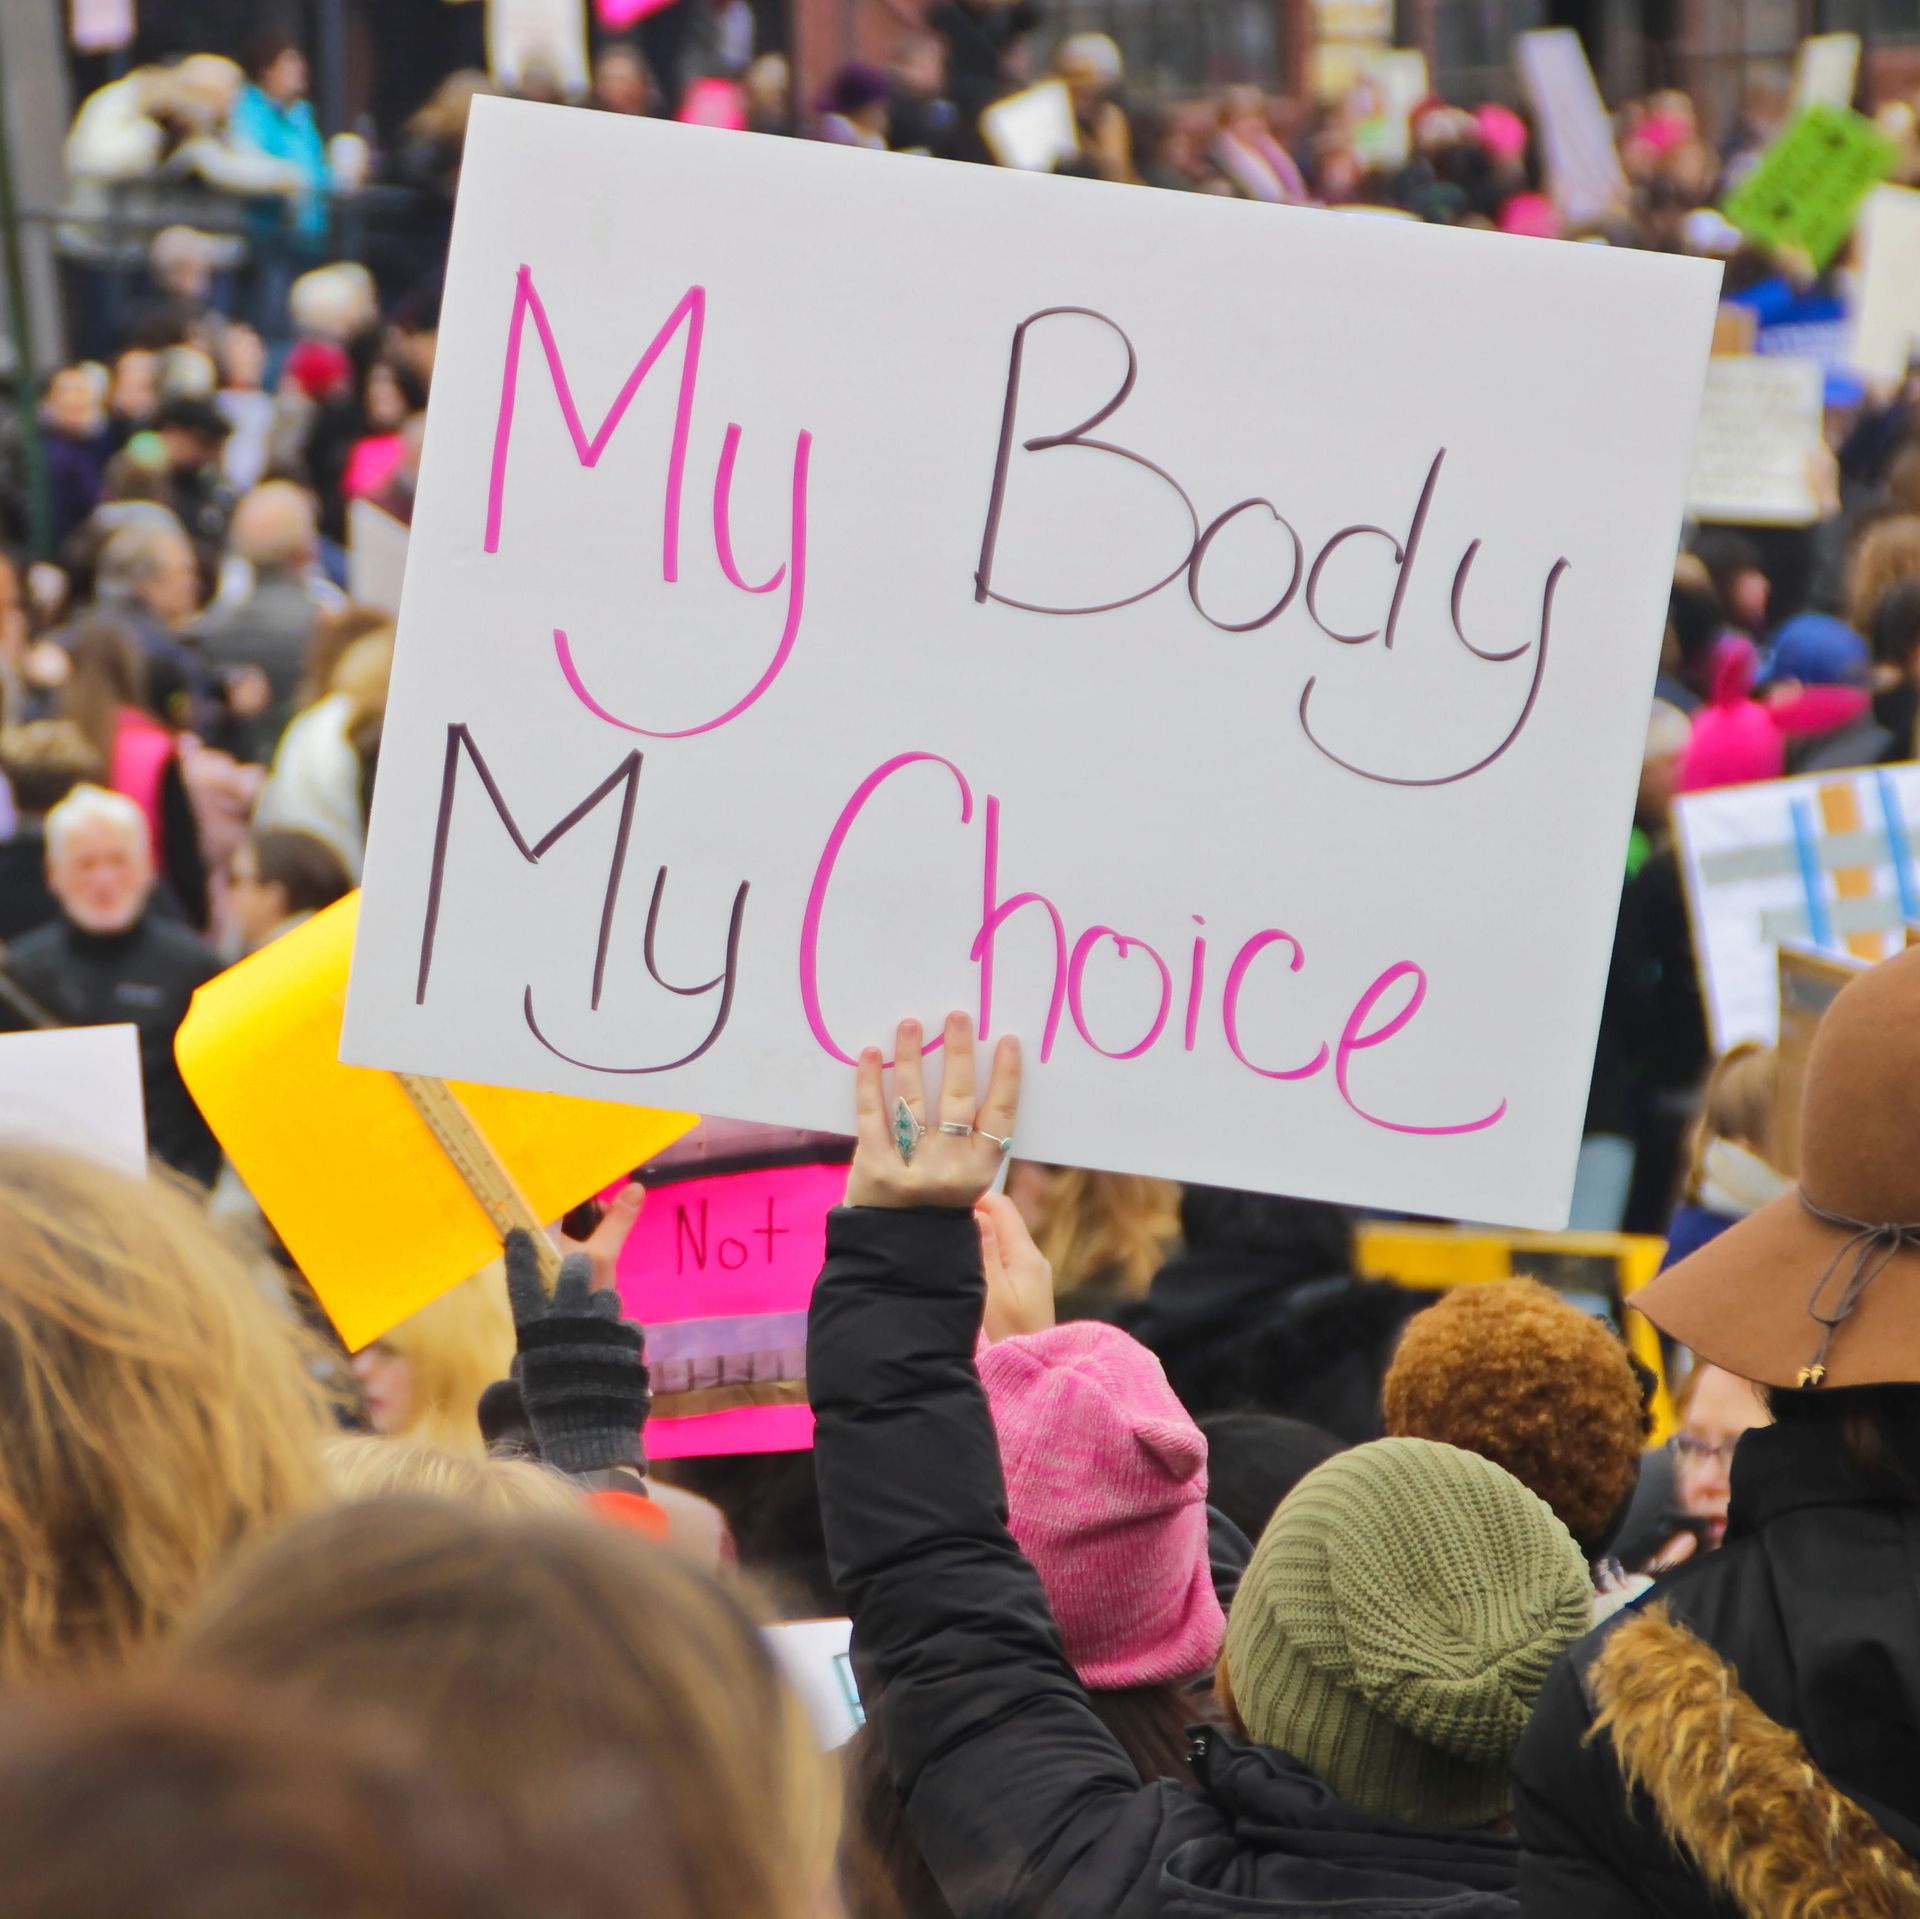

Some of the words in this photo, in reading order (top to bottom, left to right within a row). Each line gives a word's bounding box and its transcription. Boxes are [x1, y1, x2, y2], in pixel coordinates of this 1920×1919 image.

[484, 264, 812, 739] My
[974, 305, 1571, 786] Body
[415, 722, 750, 1074] My
[799, 751, 1507, 1136] Choice
[675, 1196, 790, 1275] Not
